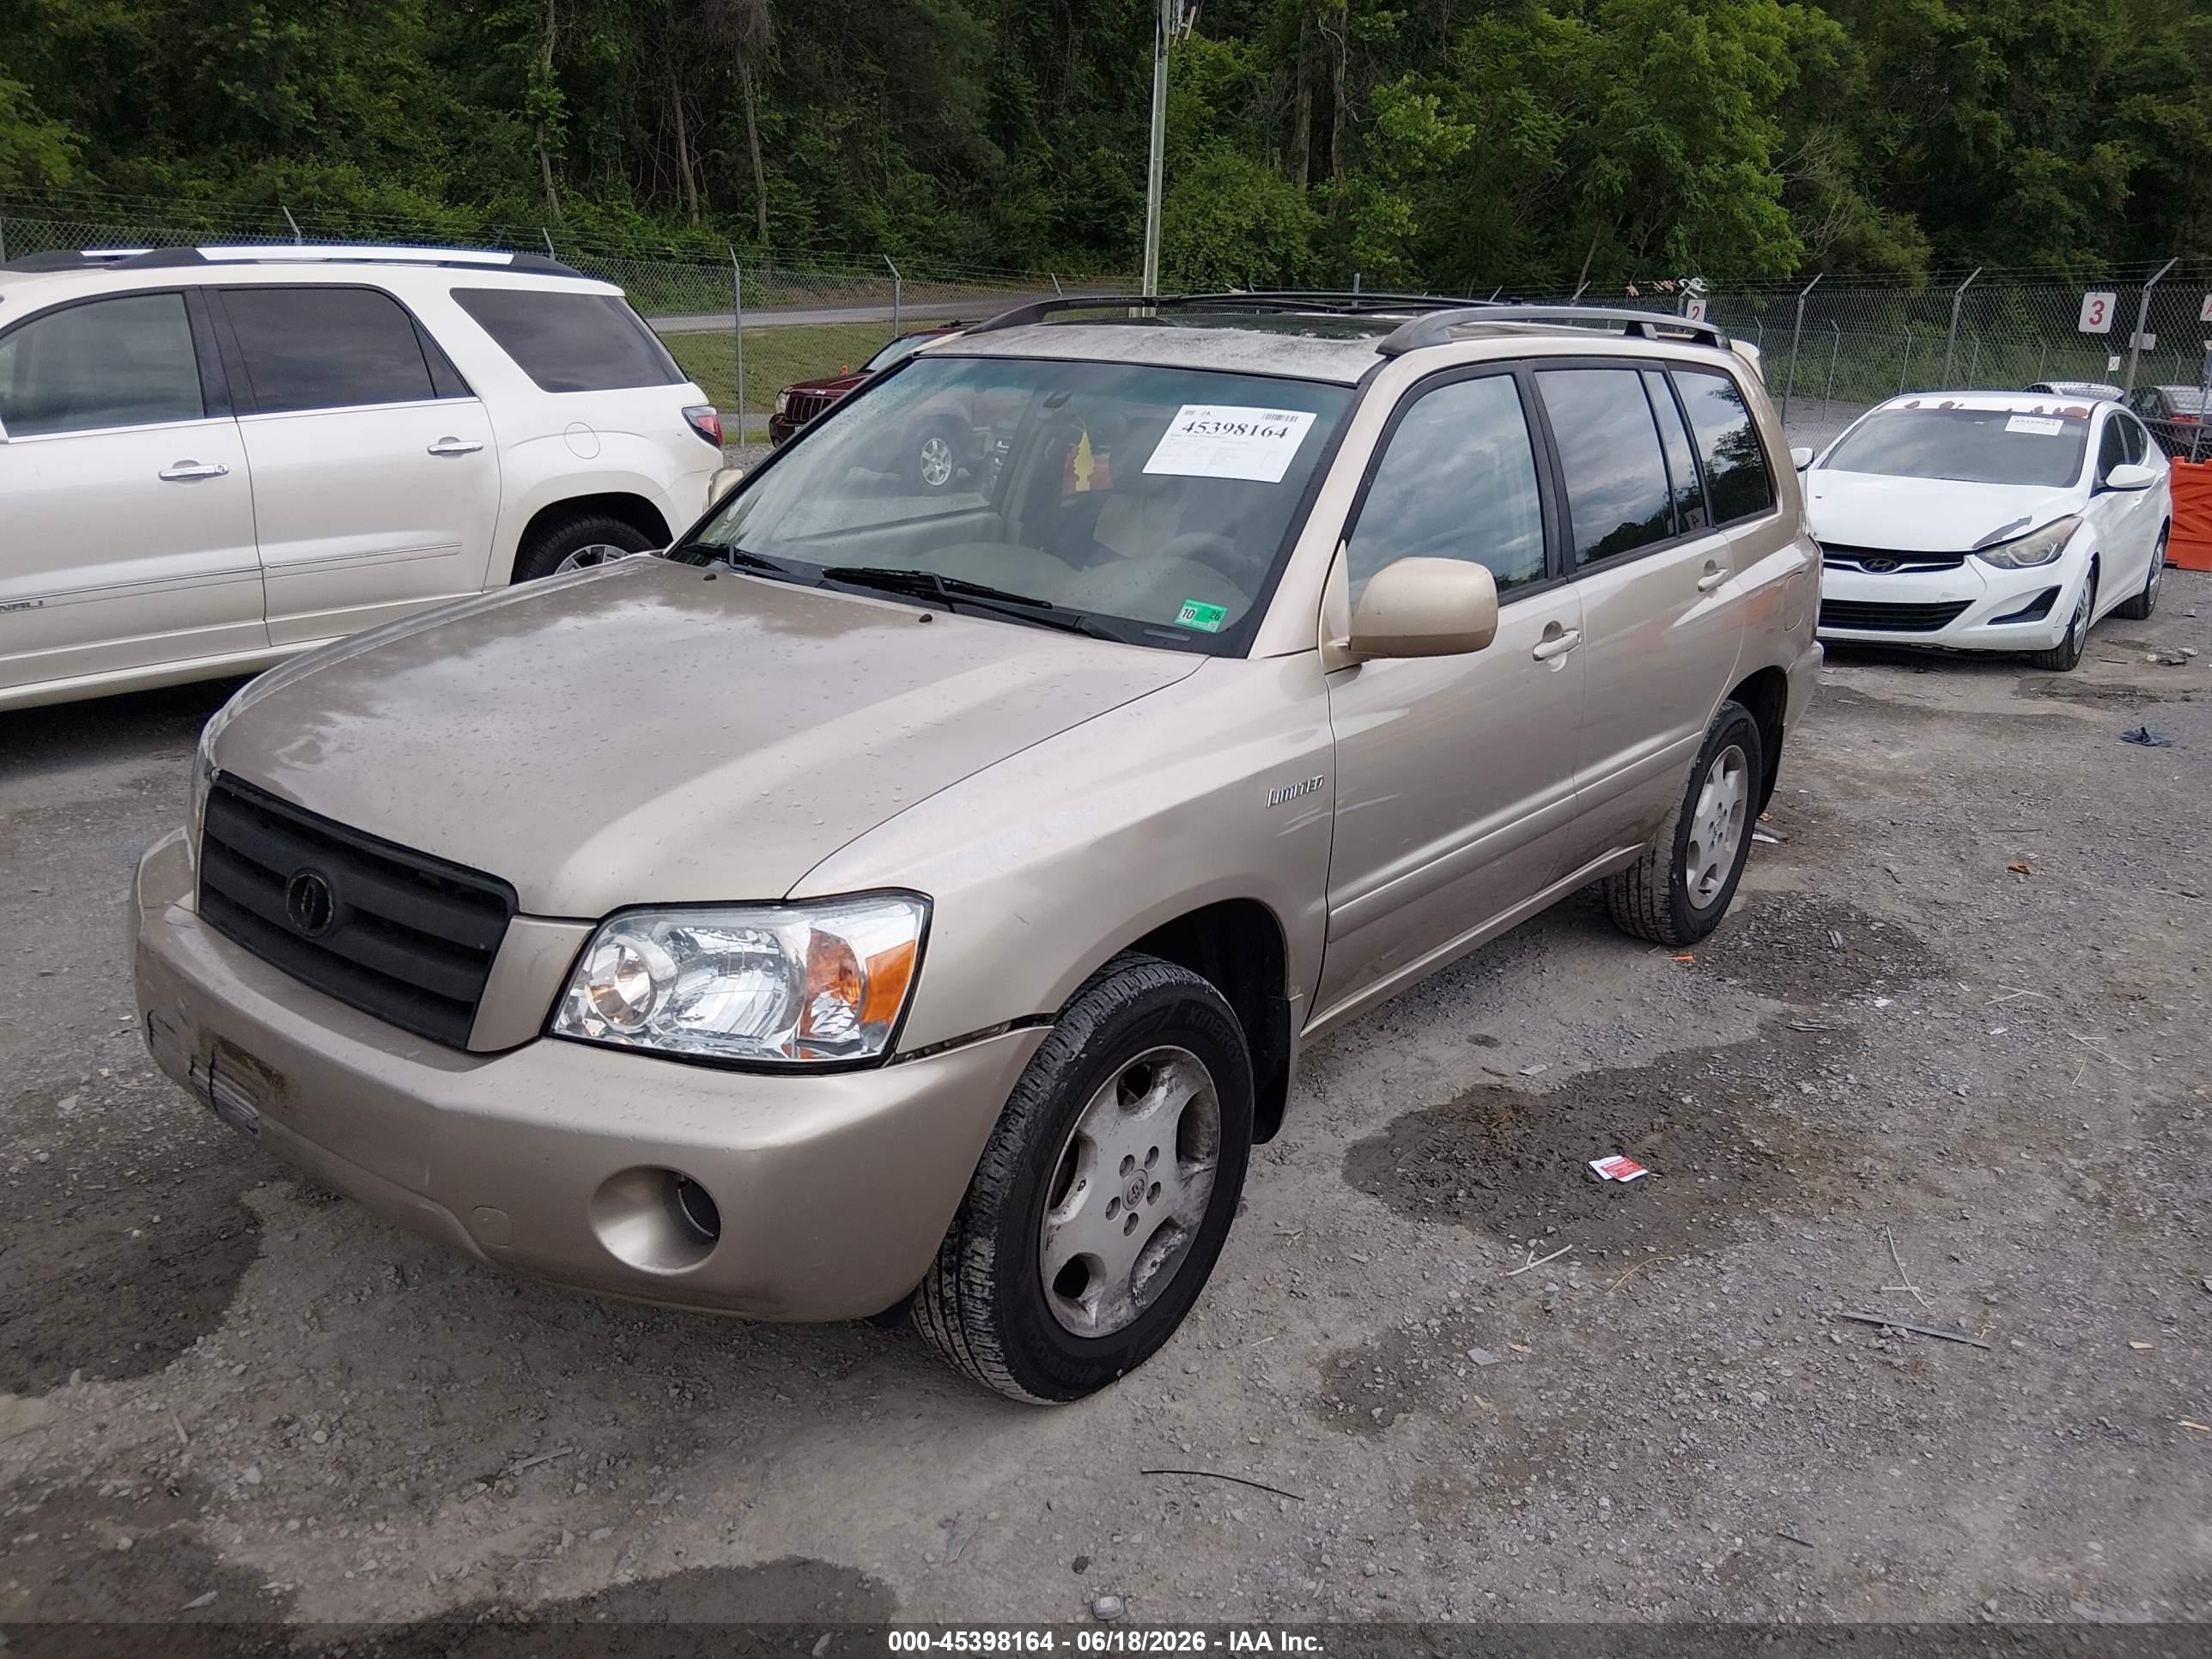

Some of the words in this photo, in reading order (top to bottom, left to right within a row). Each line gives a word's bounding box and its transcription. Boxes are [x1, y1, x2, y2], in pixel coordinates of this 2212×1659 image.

[2088, 300, 2106, 325] 3
[1182, 421, 1289, 439] 45398164
[1182, 608, 1196, 619] 10
[1209, 611, 1223, 621] 26
[1266, 775, 1324, 808] LIMITED
